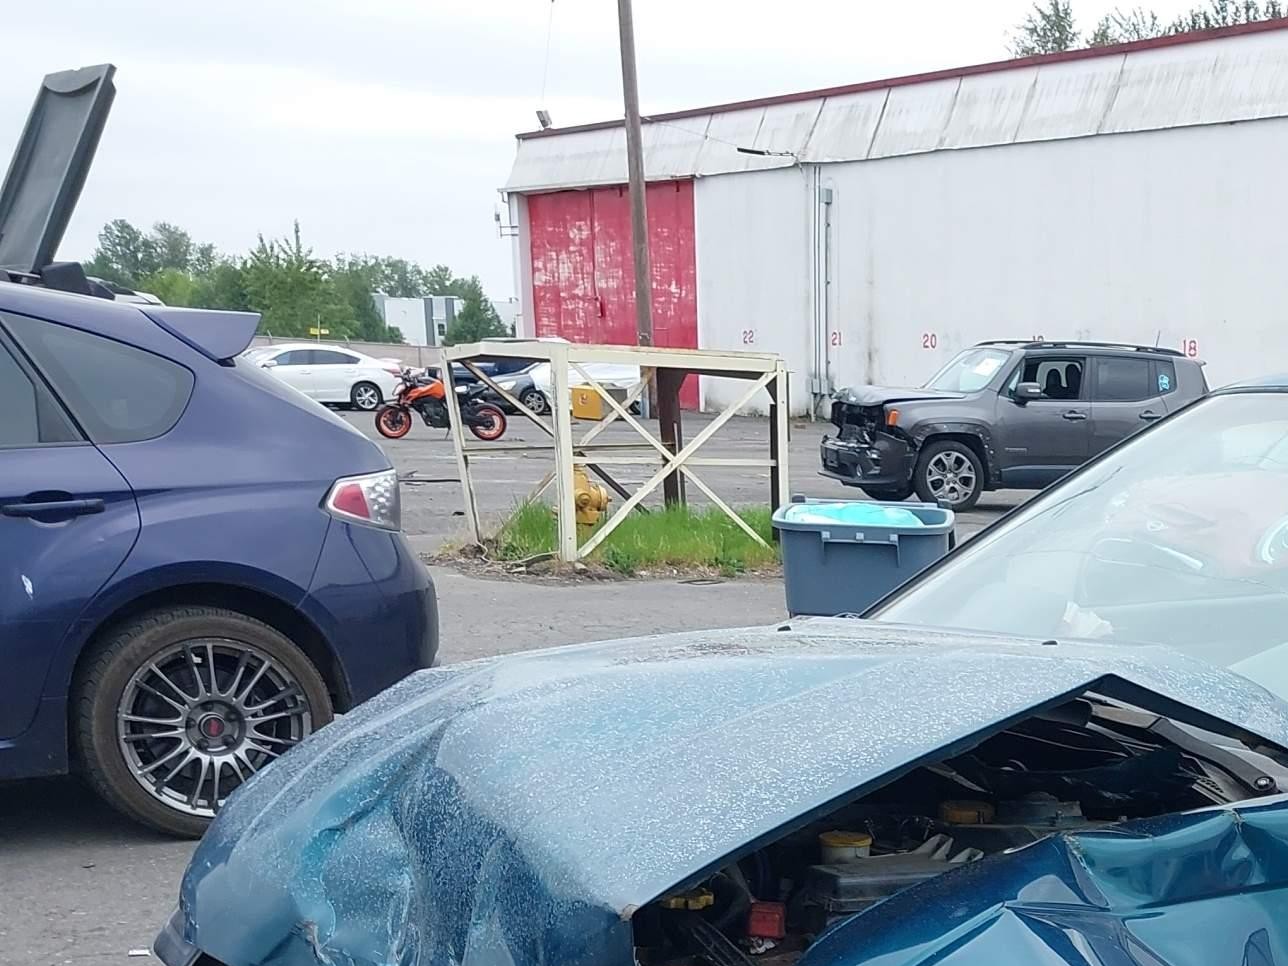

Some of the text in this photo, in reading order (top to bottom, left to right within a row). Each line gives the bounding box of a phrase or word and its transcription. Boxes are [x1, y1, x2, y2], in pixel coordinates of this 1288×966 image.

[743, 330, 754, 344] 22
[831, 332, 842, 346] 21
[922, 334, 937, 349] 20
[1183, 339, 1197, 357] 18
